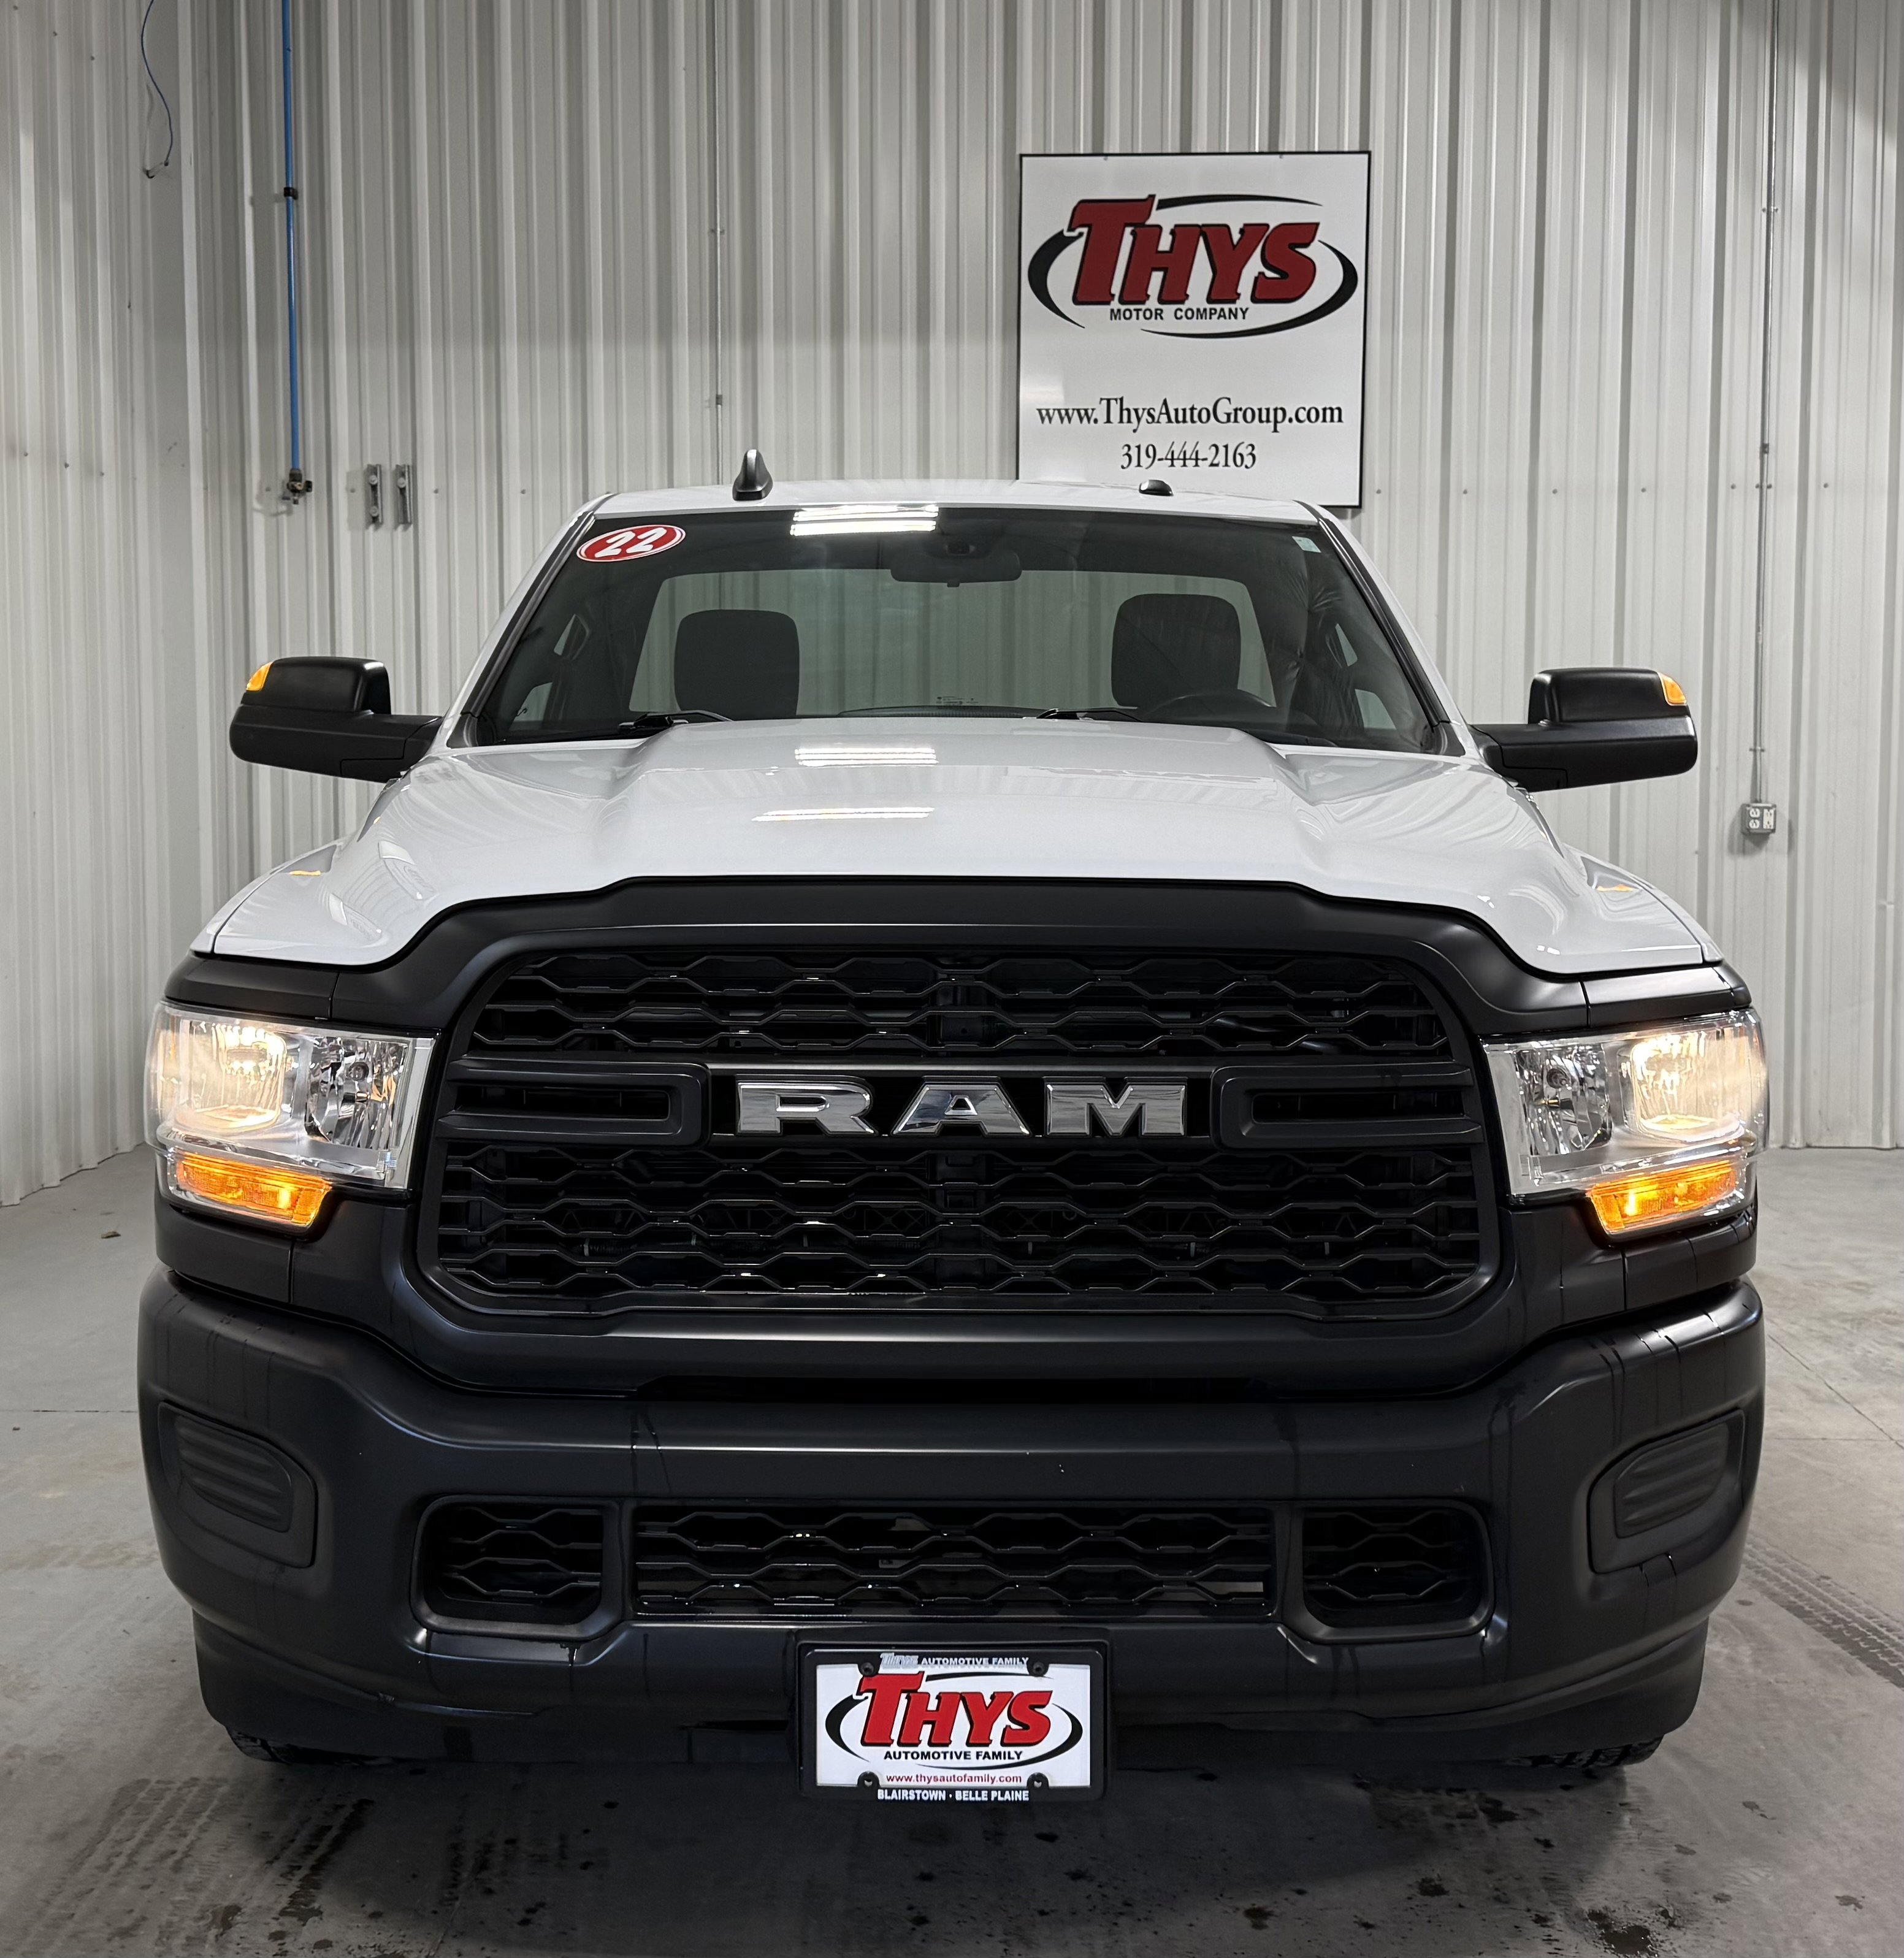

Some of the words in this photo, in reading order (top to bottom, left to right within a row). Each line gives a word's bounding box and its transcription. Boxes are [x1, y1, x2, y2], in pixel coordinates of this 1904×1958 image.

[1068, 194, 1320, 305] THYS
[1109, 308, 1164, 321] MOTOR
[1174, 307, 1250, 321] COMPANY
[1036, 396, 1344, 433] www.ThysAutoGroup.com
[1120, 441, 1257, 470] 319-444-2163
[594, 527, 667, 558] 22
[737, 1079, 1187, 1137] RAM
[921, 1657, 988, 1666] AUTOMOTIVE
[992, 1657, 1029, 1665] FAMILY
[856, 1671, 1053, 1747] THYS
[884, 1751, 971, 1760] AUTOMOTIVE
[976, 1751, 1023, 1760] FAMILY
[886, 1774, 1022, 1784] www.thysautofamily.com
[877, 1789, 946, 1800] BLAIRSTOWN
[955, 1790, 988, 1801] BELLE
[991, 1790, 1030, 1801] PLAINE
